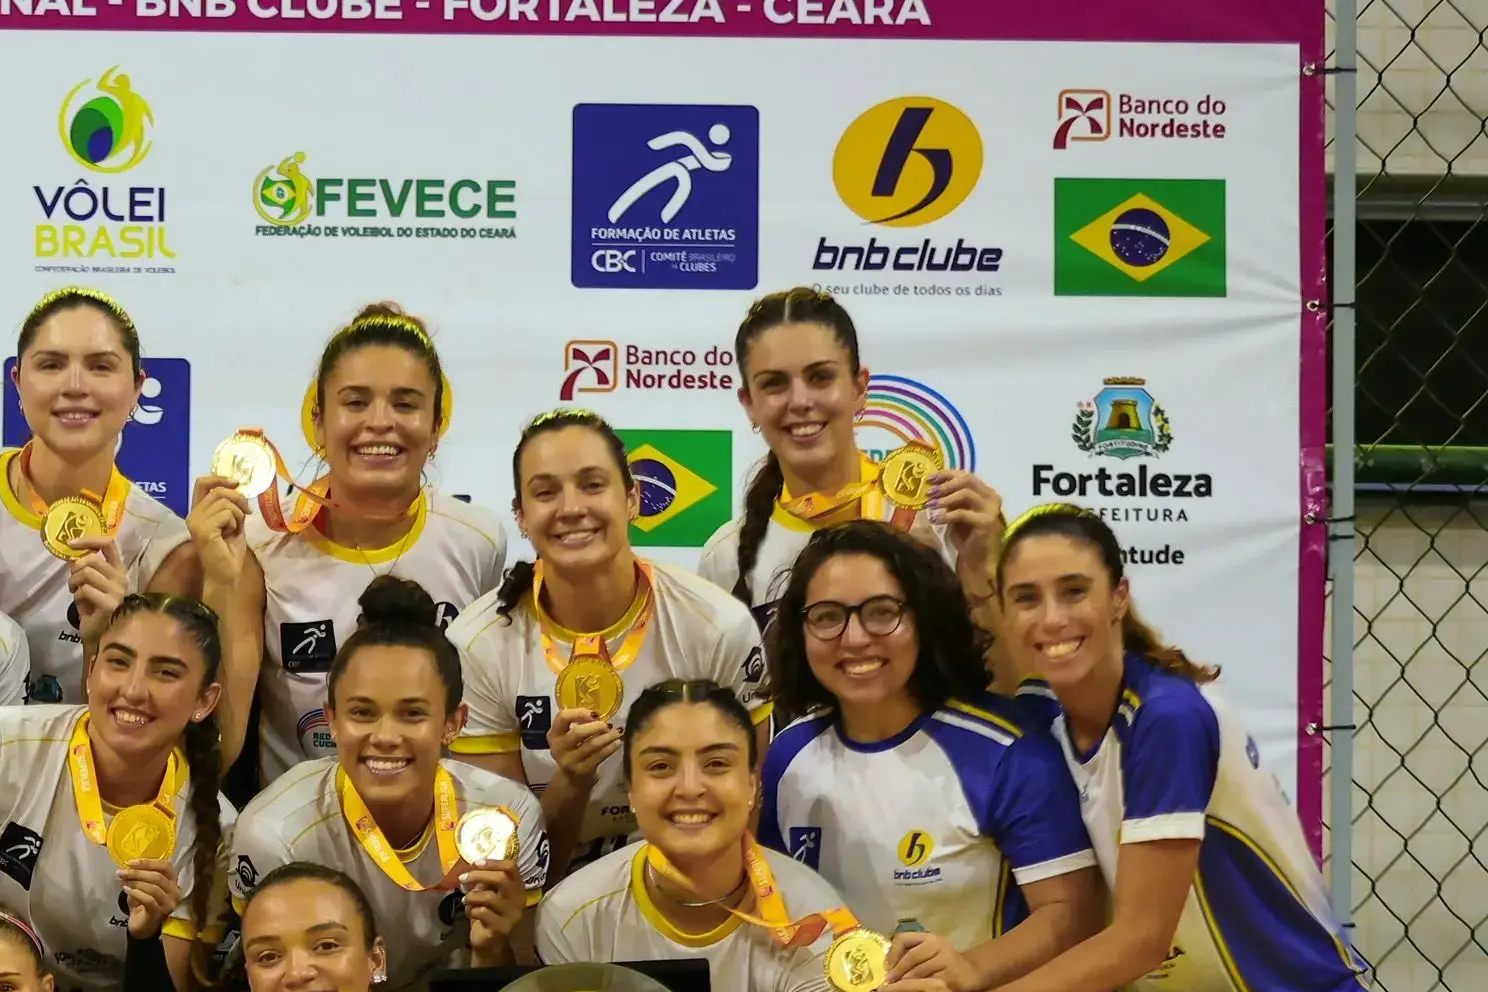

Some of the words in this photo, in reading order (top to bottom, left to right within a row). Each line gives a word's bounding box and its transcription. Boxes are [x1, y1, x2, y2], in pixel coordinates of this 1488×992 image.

[136, 0, 237, 17] BNB
[248, 0, 402, 19] CLUBE
[443, 0, 725, 23] FORTALEZA
[1119, 95, 1186, 115] Banco
[1197, 94, 1226, 115] do
[1119, 118, 1226, 139] Nordeste
[33, 178, 165, 222] VÔLEI
[316, 178, 516, 218] FEVECE
[35, 225, 176, 258] BRASIL
[255, 224, 321, 238] FEDERAÇÃO
[324, 226, 338, 237] DE
[341, 226, 394, 237] VOLEIBOL
[397, 227, 412, 238] DO
[415, 227, 457, 238] ESTADO
[460, 228, 476, 239] DO
[479, 225, 516, 239] CEARÁ
[591, 227, 661, 242] FORMAÇÃO
[663, 229, 680, 240] DE
[682, 229, 736, 240] ATLETAS
[591, 250, 637, 273] CBC
[650, 251, 687, 262] COMITÊ
[679, 262, 717, 272] CLUBES
[827, 286, 849, 295] seu
[853, 284, 889, 295] clube
[893, 284, 909, 295] de
[914, 284, 952, 296] todos
[955, 287, 970, 296] os
[975, 284, 1002, 296] dias
[626, 345, 696, 366] Banco
[704, 344, 733, 366] do
[625, 369, 733, 390] Nordeste
[1032, 464, 1212, 498] Fortaleza
[1089, 508, 1189, 522] FEITURA
